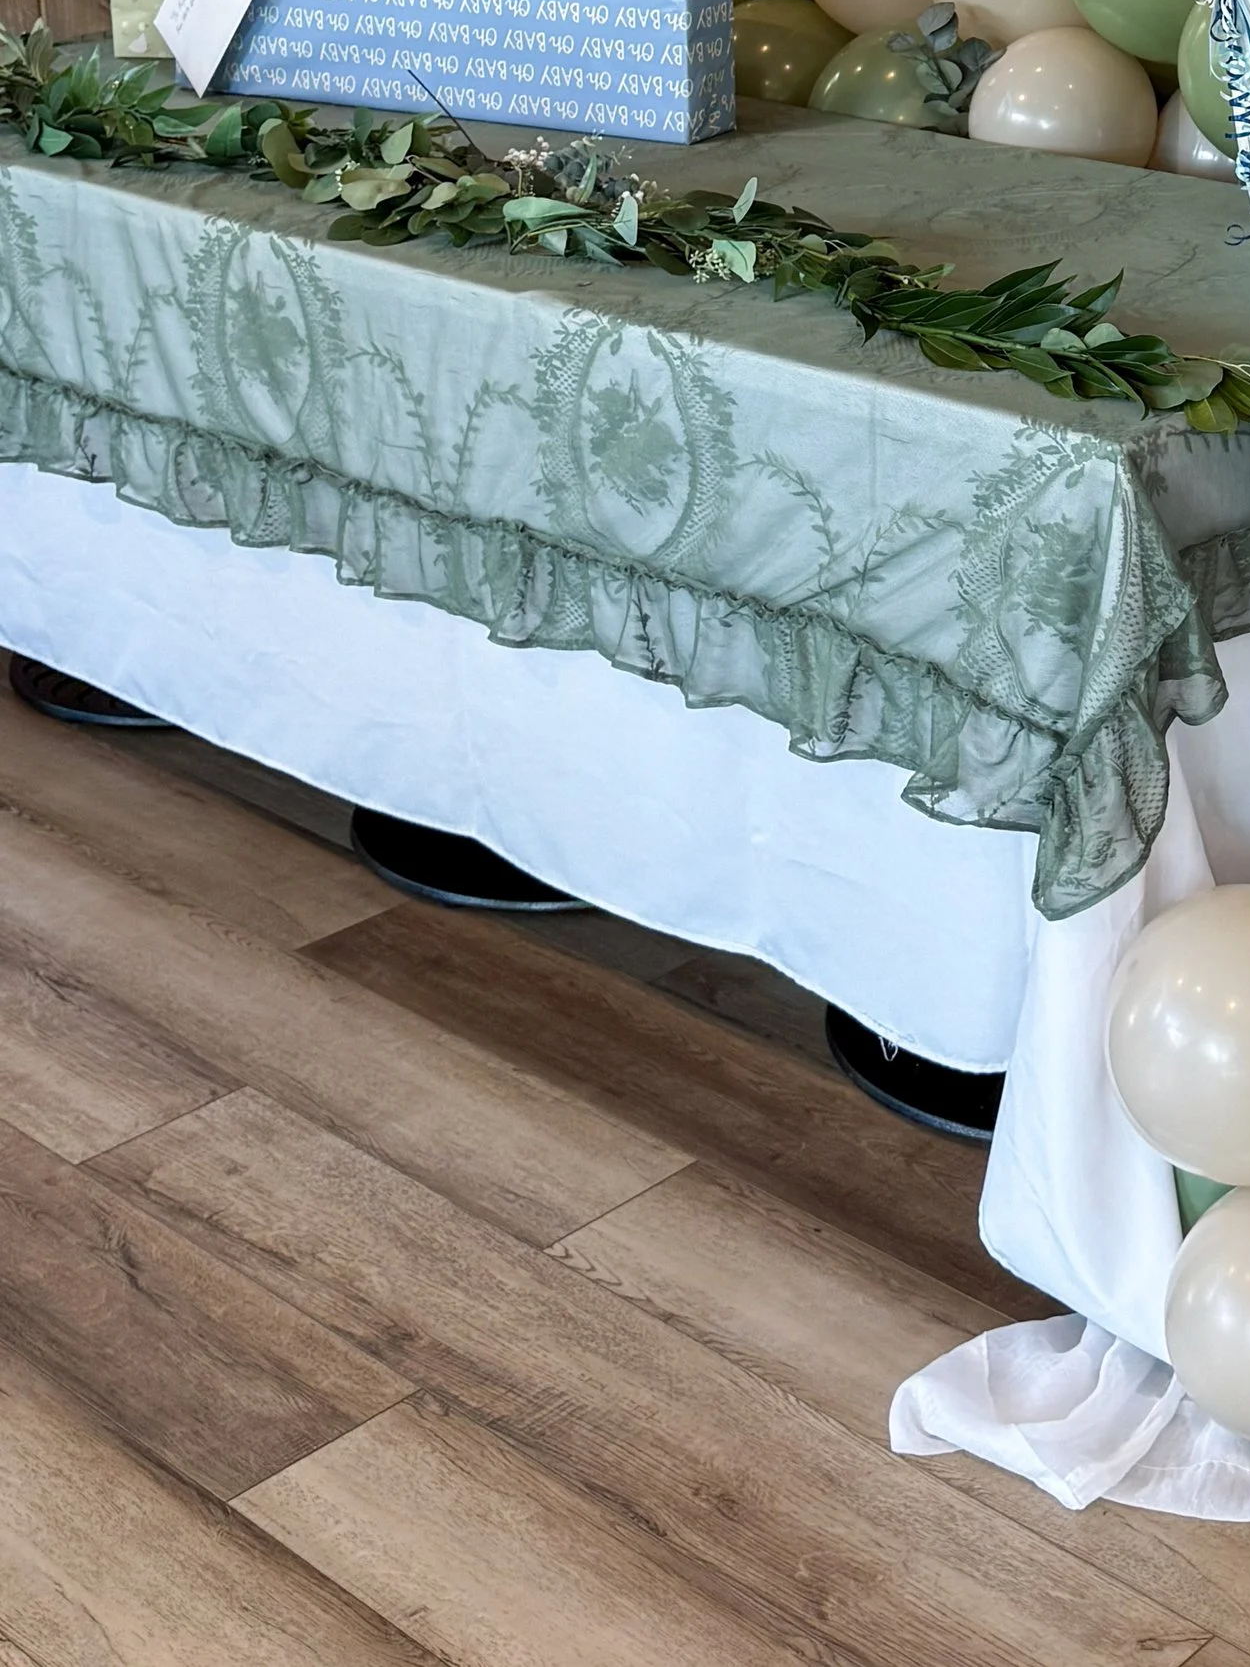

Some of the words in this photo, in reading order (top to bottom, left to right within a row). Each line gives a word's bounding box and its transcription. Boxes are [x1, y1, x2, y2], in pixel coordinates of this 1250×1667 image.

[283, 7, 324, 31] BABY
[326, 13, 350, 32] Oh
[536, 0, 580, 24] BABY
[583, 4, 609, 25] Oh
[614, 6, 661, 31] BABY
[664, 10, 692, 31] Oh
[354, 14, 396, 38] BABY
[398, 19, 422, 39] Oh
[428, 22, 470, 45] BABY
[472, 27, 497, 47] Oh
[503, 29, 546, 53] BABY
[548, 34, 574, 55] Oh
[289, 40, 313, 59] Oh
[320, 42, 360, 64] BABY
[361, 47, 386, 66] Oh
[580, 36, 625, 61] BABY
[627, 42, 654, 62] Oh
[660, 41, 704, 67] BABY
[391, 49, 432, 73] BABY
[434, 55, 459, 74] Oh
[465, 57, 507, 81] BABY
[263, 67, 287, 86] Oh
[291, 69, 331, 93] BABY
[509, 63, 535, 83] Oh
[540, 64, 583, 89] BABY
[586, 70, 612, 91] Oh
[332, 75, 356, 95] Oh
[361, 77, 402, 101] BABY
[617, 73, 663, 97] BABY
[666, 78, 694, 98] Oh
[433, 85, 476, 109] BABY
[478, 91, 503, 111] Oh
[508, 93, 551, 117] BABY
[553, 100, 579, 120] Oh
[584, 102, 628, 126] BABY
[631, 108, 657, 128] Oh
